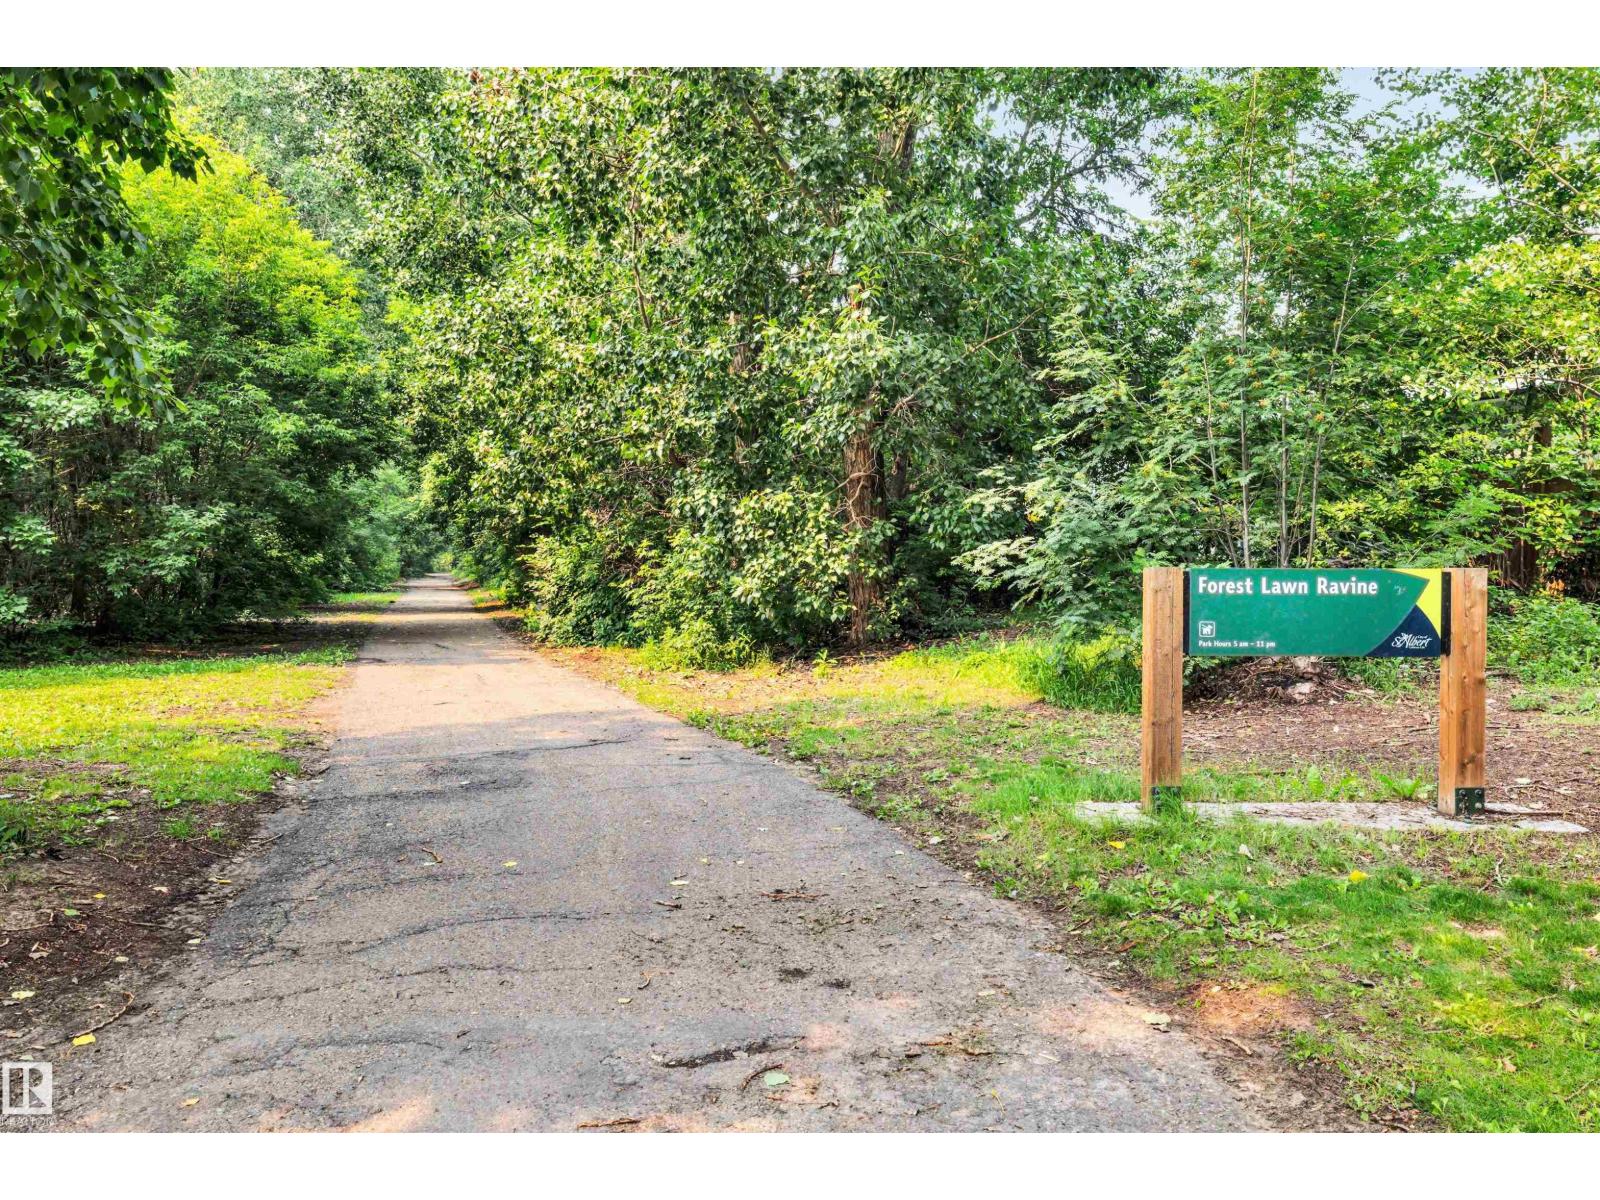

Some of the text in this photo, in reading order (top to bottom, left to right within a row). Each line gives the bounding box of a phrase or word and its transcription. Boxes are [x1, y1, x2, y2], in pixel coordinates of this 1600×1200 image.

[1198, 576, 1378, 594] Forest Lawn Ravine
[1266, 641, 1276, 649] pm
